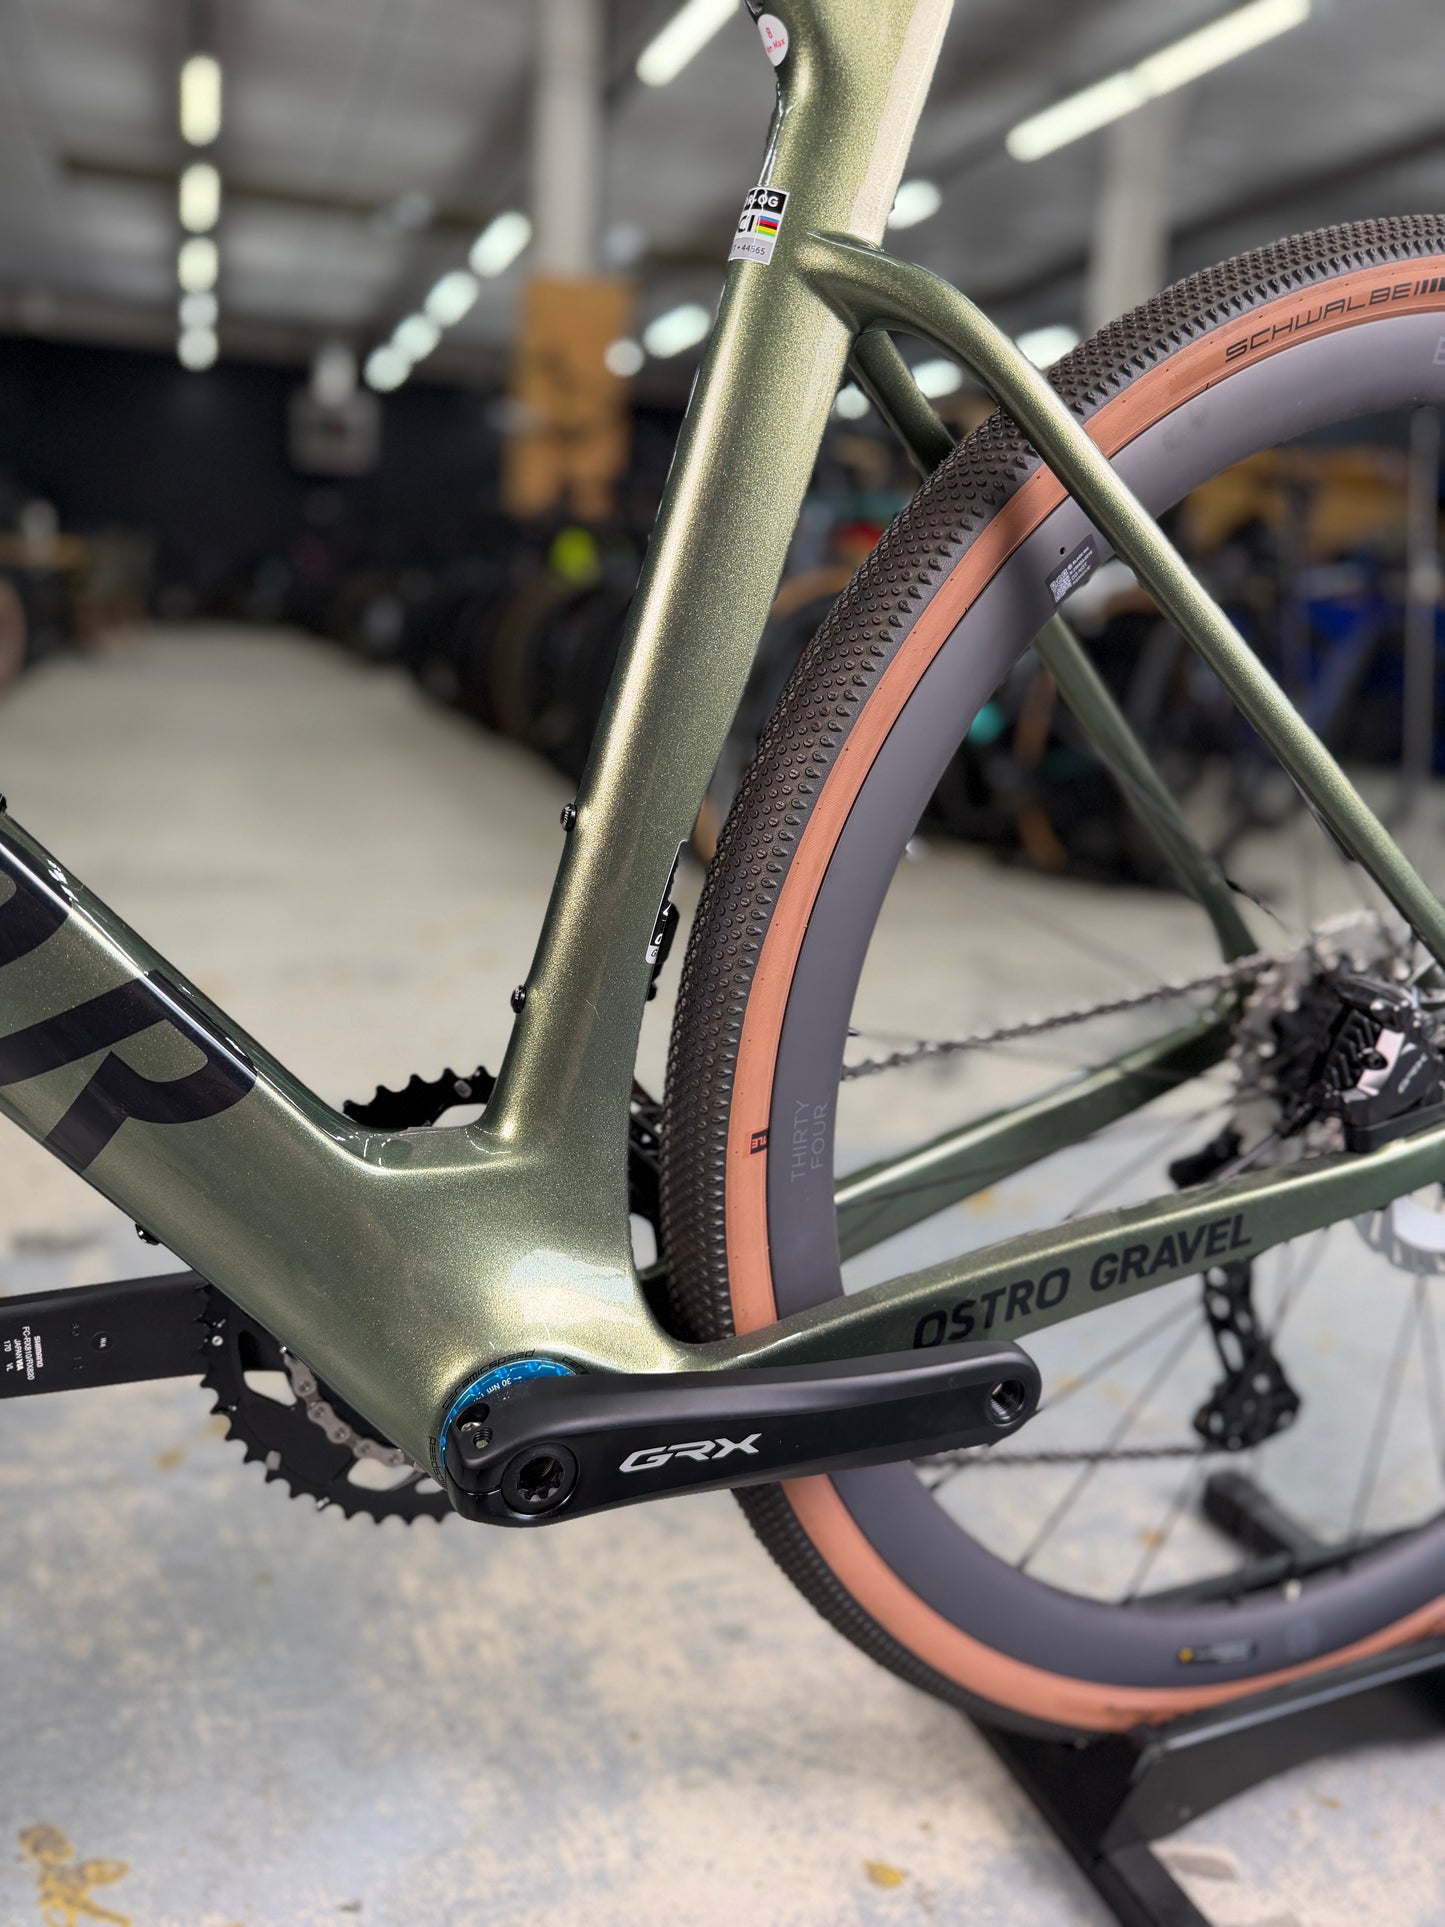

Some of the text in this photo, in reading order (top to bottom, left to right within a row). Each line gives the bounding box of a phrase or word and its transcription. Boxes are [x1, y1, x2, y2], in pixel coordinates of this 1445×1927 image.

[1225, 282, 1412, 363] SCHWALBE
[790, 1100, 810, 1184] THIRTY
[810, 1102, 829, 1169] FOUR
[913, 1213, 1252, 1350] OSTRO GRAVEL
[3, 1340, 12, 1352] 170
[14, 1338, 23, 1359] JAPAN
[34, 1335, 44, 1368] SHIMANO
[486, 1377, 512, 1394] 30 Nm
[619, 1433, 762, 1473] GRX
